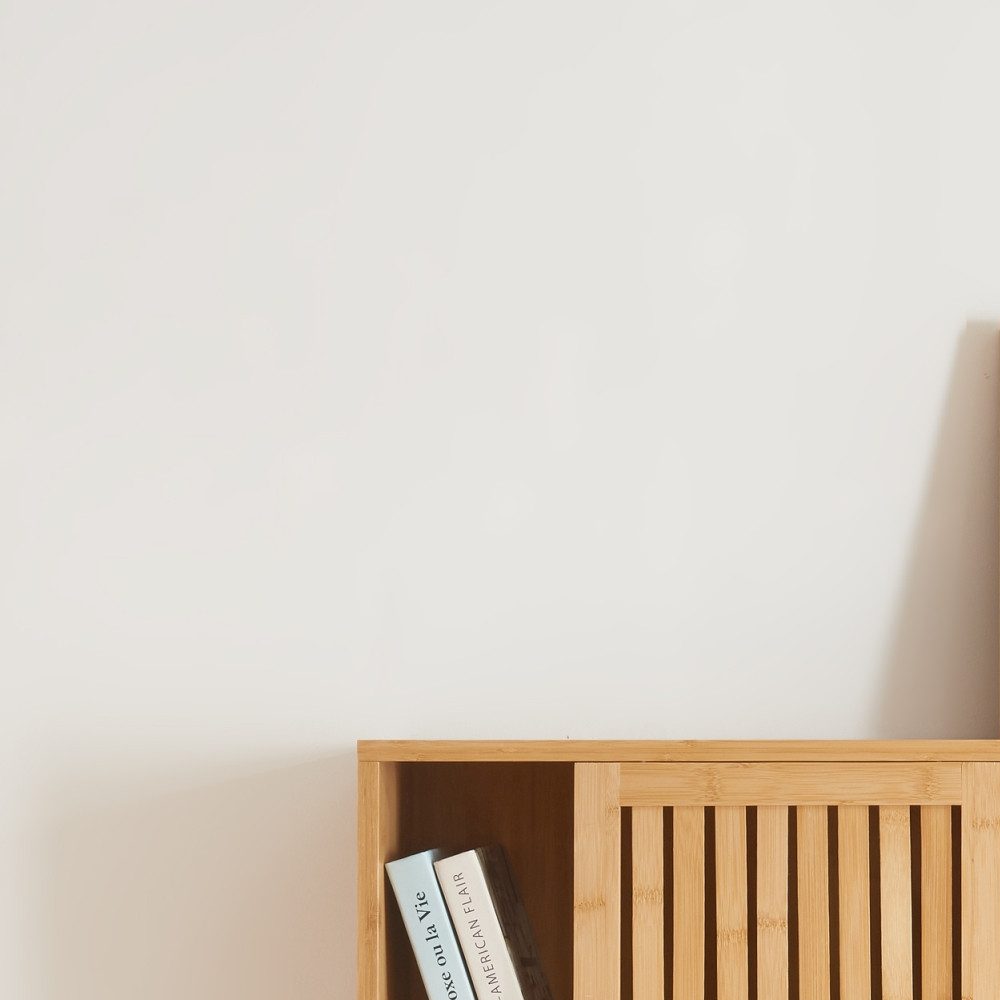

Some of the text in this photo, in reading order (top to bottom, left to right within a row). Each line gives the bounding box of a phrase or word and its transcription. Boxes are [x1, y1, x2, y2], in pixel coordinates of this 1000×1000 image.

[453, 872, 475, 914] FLAIR
[414, 891, 431, 923] Vie
[425, 923, 440, 942] la
[433, 944, 447, 967] ou
